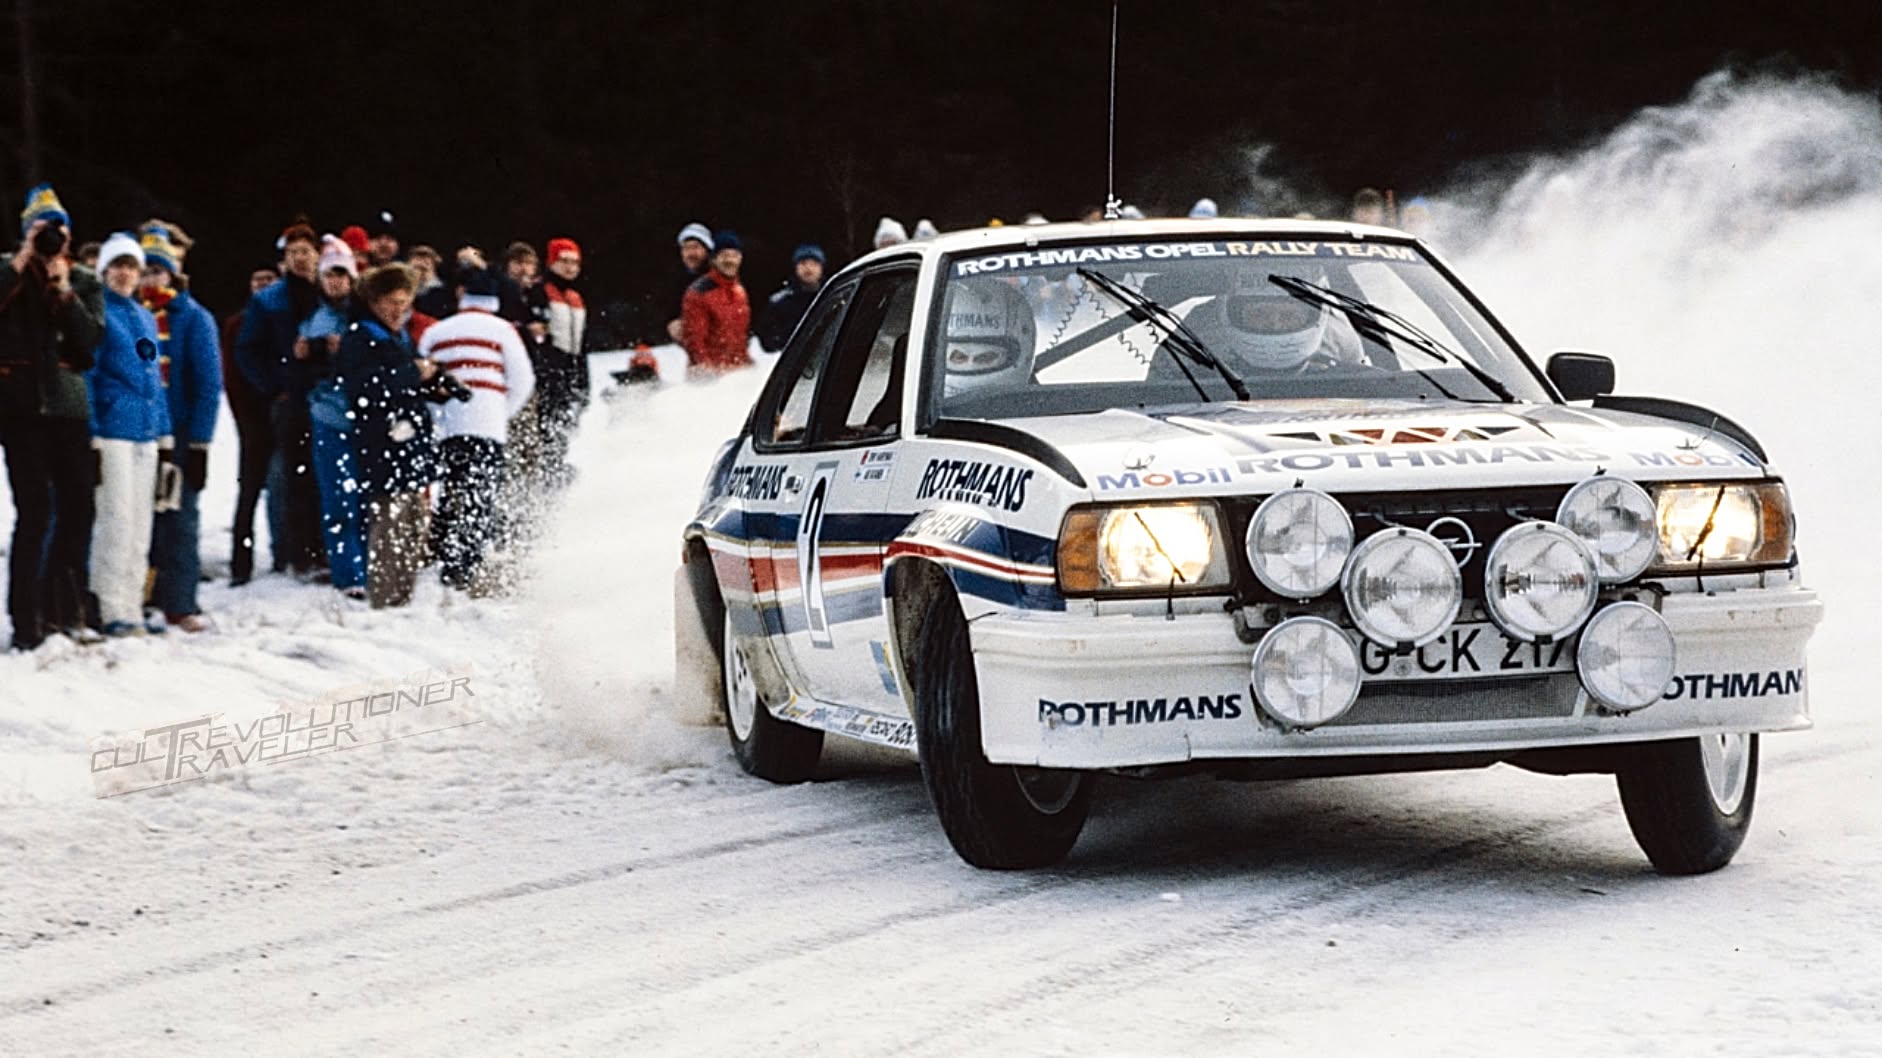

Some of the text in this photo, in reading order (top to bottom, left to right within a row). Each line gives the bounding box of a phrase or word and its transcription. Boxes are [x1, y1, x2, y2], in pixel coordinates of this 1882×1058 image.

[957, 242, 1417, 276] ROTHMANS OPEL RALLY TEAM
[948, 312, 1000, 330] THMANS
[1236, 446, 1609, 475] ROTHMANS
[916, 459, 1034, 512] ROTHMANS
[1097, 467, 1232, 490] Mobil
[1662, 668, 1803, 700] OTHMAN
[1039, 694, 1242, 726] ROTHMANS
